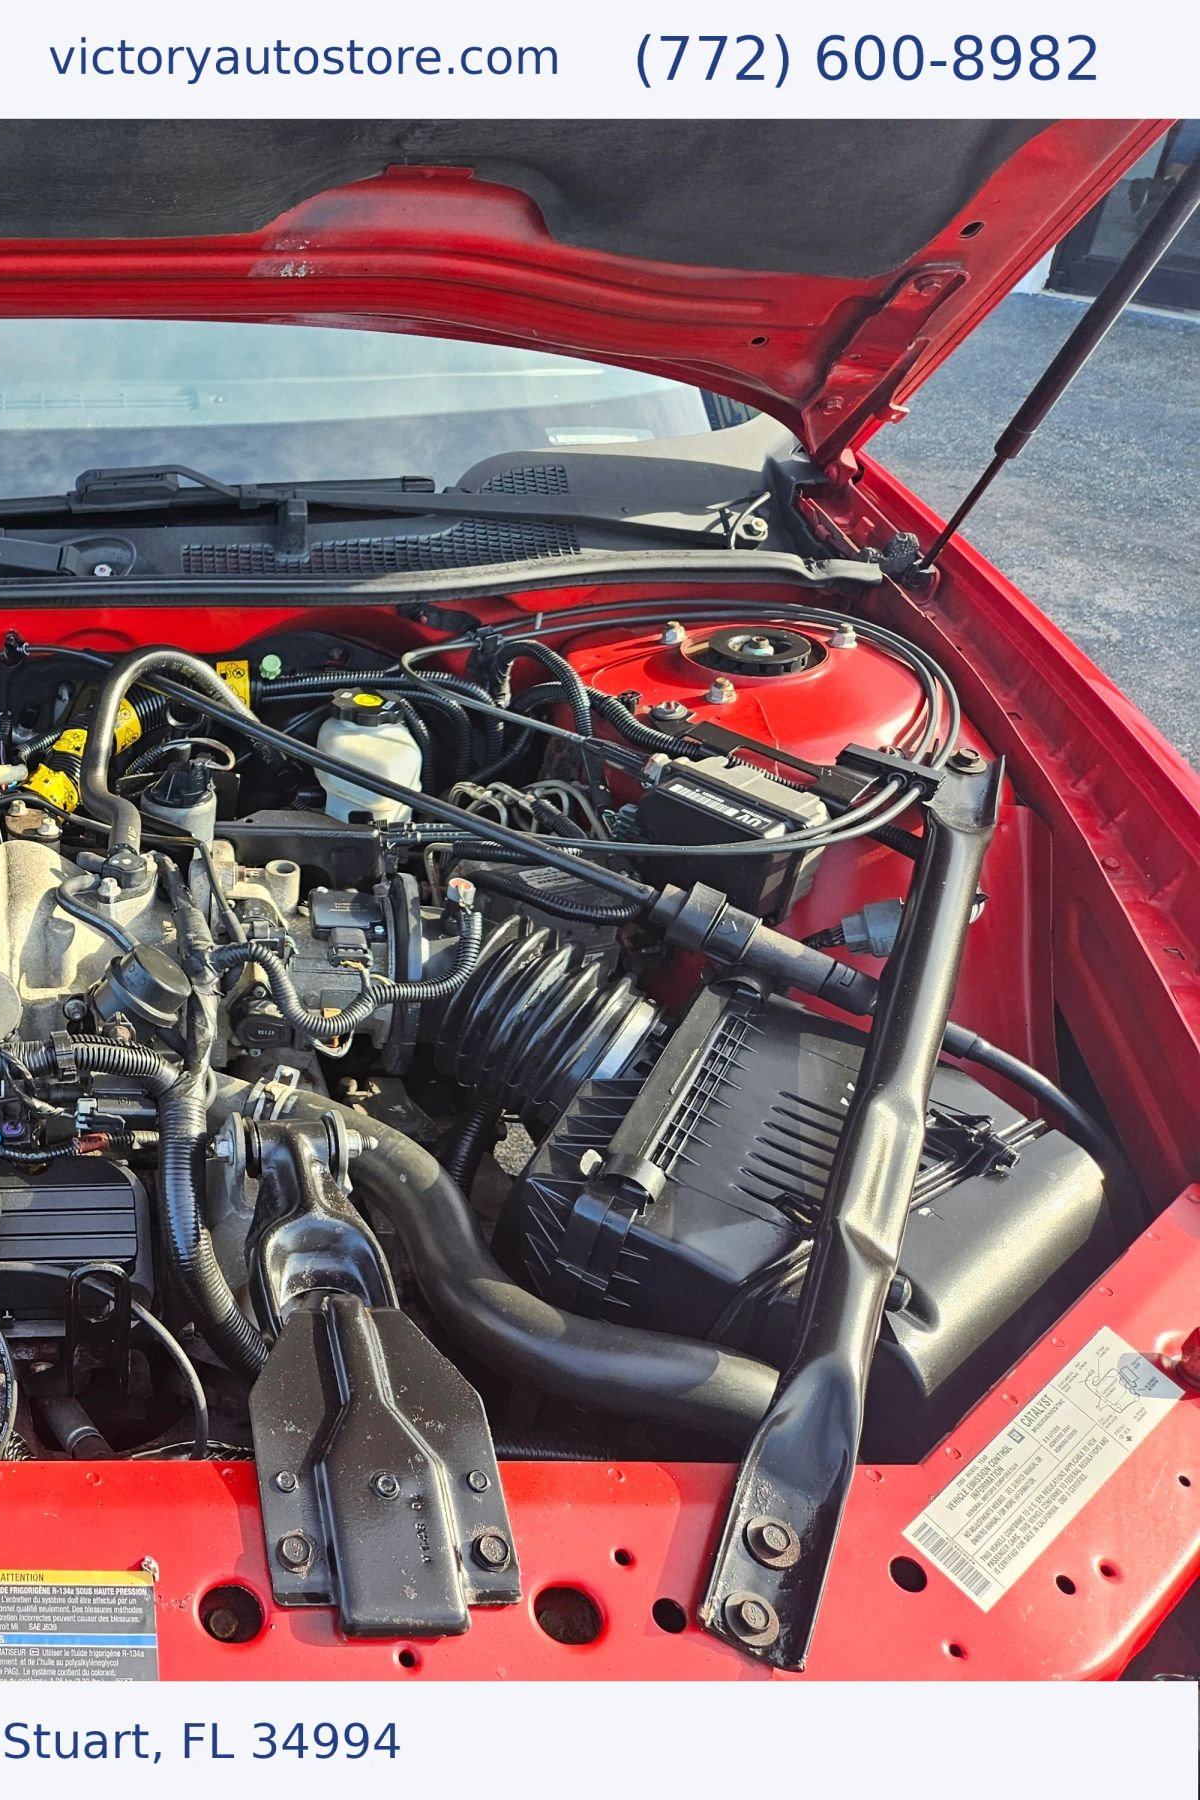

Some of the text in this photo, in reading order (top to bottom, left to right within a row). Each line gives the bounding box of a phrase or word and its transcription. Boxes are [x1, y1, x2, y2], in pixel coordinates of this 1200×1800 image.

[1019, 1393, 1055, 1428] CATALYST
[945, 1443, 1013, 1511] VEHICLE EMISSION CONTROL
[969, 1464, 1005, 1500] INFORMATION
[965, 1499, 983, 1518] GENERAL
[994, 1462, 1019, 1487] CORPORATION
[988, 1534, 1006, 1553] VEHICLE
[1002, 1513, 1026, 1538] CONFORMS
[1041, 1469, 1067, 1496] REGULATIONS
[1063, 1449, 1085, 1473] APPLICABLE
[985, 1542, 1011, 1569] PASSENGER
[1026, 1506, 1045, 1525] VEHICLE
[1040, 1487, 1063, 1510] CONFORMS
[1063, 1466, 1081, 1485] FEDERAL
[1077, 1443, 1103, 1470] REGULATIONS
[967, 1506, 994, 1533] ADJUSTMENTS
[997, 1547, 1019, 1570] CERTIFIED
[0, 1573, 44, 1581] ATTENTION
[1, 1596, 32, 1604] L'entretien
[33, 1596, 41, 1604] du
[118, 1596, 127, 1604] par
[10, 1586, 50, 1594] FRIGORIGÈNE
[53, 1614, 75, 1623] peuvent
[77, 1614, 98, 1623] causer
[100, 1614, 109, 1623] des
[72, 1605, 83, 1613] Des
[28, 1658, 35, 1666] de
[32, 1668, 56, 1676] système
[58, 1668, 80, 1676] contient
[82, 1668, 90, 1676] du
